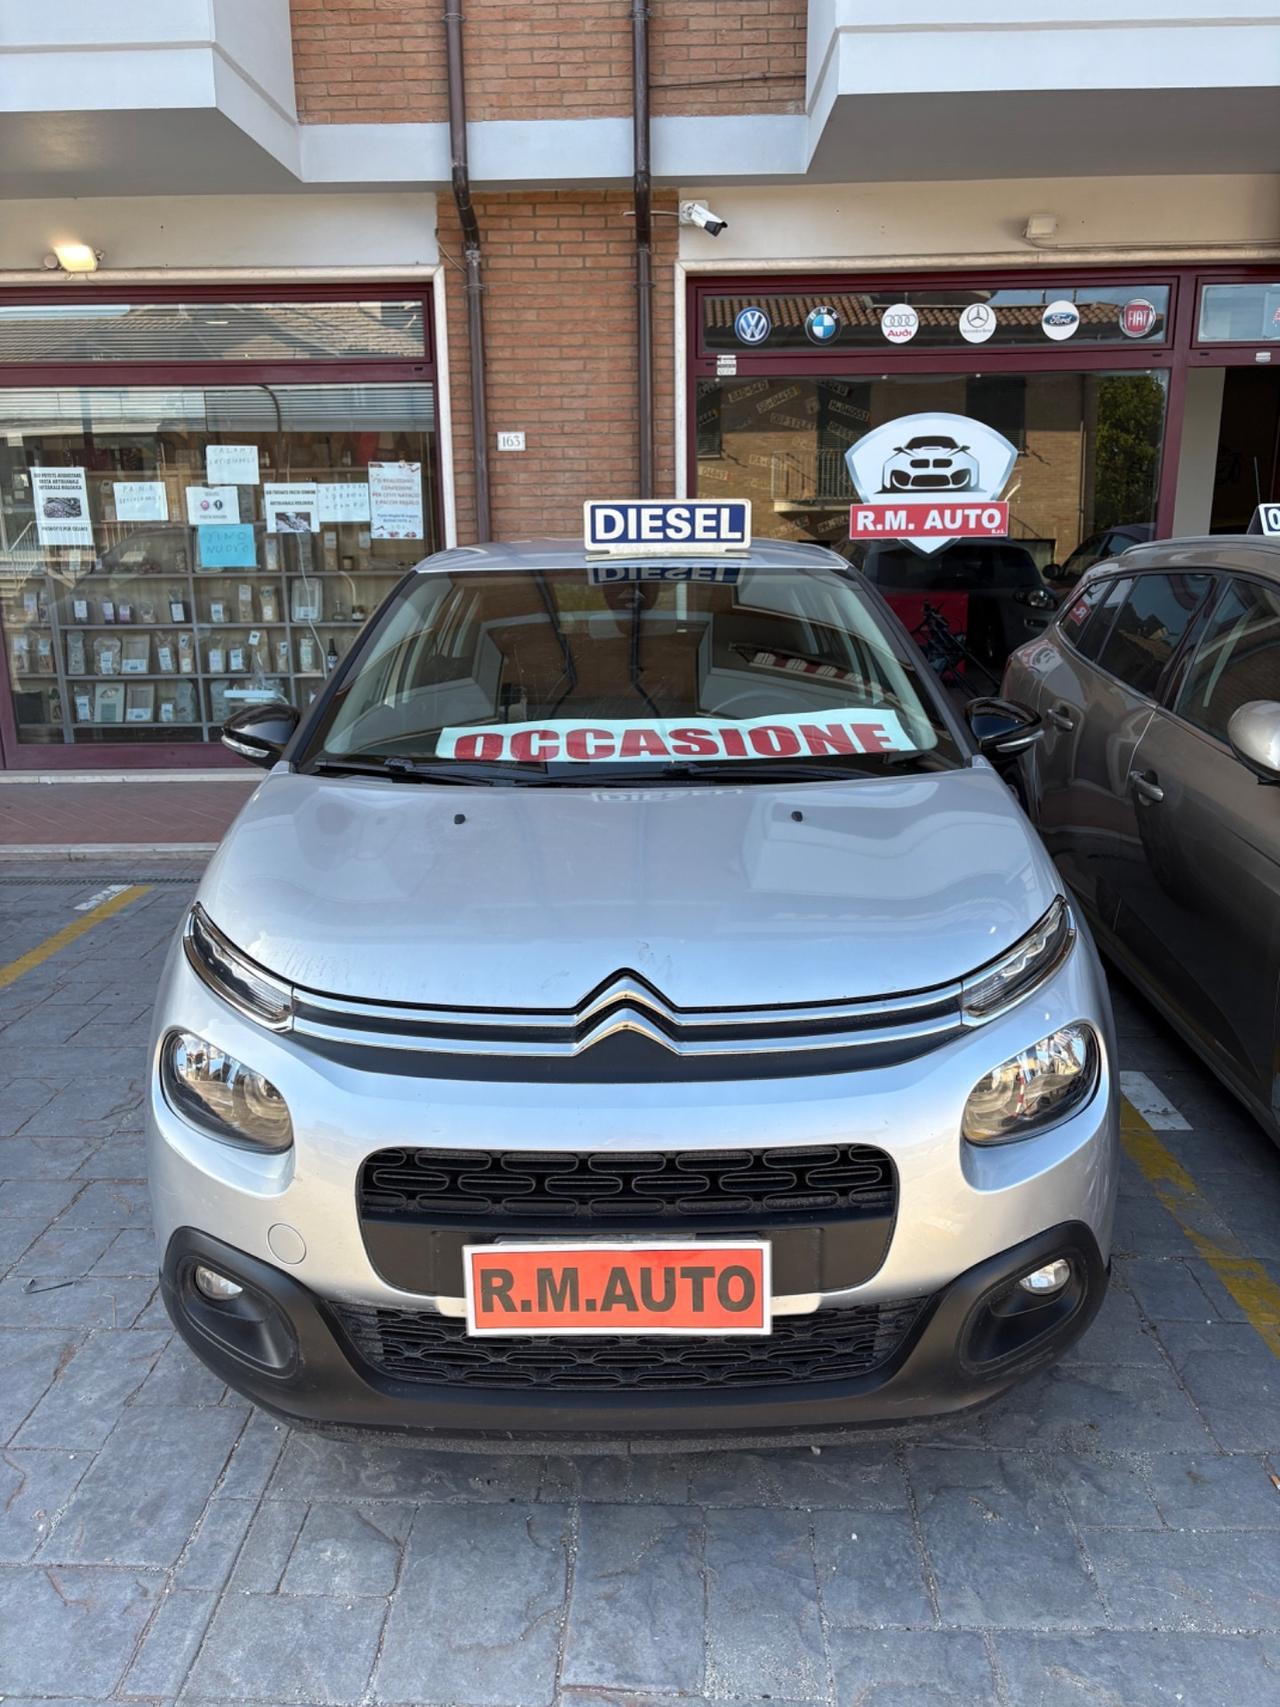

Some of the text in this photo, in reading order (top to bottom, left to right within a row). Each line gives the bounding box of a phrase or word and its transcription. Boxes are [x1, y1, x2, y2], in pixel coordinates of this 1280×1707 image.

[1127, 310, 1150, 326] FIAT
[887, 329, 913, 337] Audi
[594, 507, 743, 540] DIESEL
[856, 509, 915, 531] R.M.
[924, 508, 1001, 530] AUTO
[454, 723, 901, 762] OCCASIONE
[480, 1265, 756, 1313] R.M.AUTO
